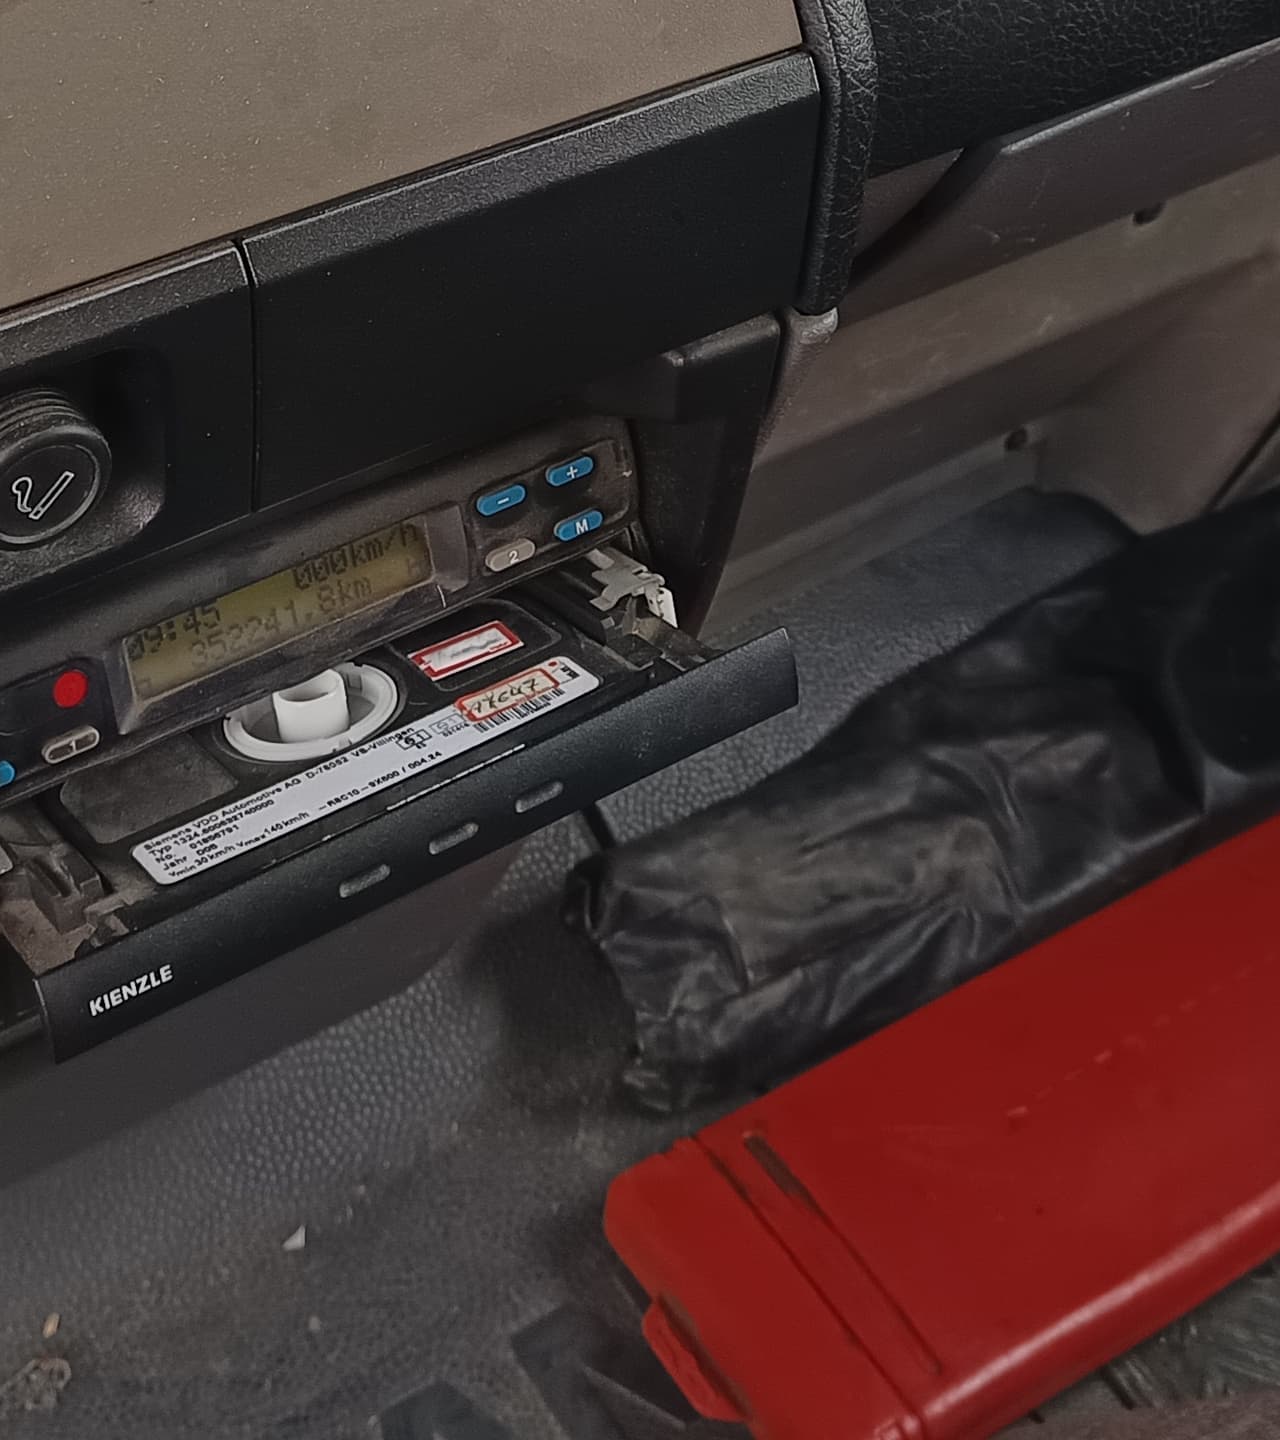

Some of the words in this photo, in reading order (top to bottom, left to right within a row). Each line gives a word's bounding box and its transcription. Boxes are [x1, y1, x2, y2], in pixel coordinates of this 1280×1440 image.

[575, 518, 589, 535] M
[508, 550, 520, 565] 2
[192, 814, 219, 829] VDO
[89, 964, 173, 1017] KIENZLE
